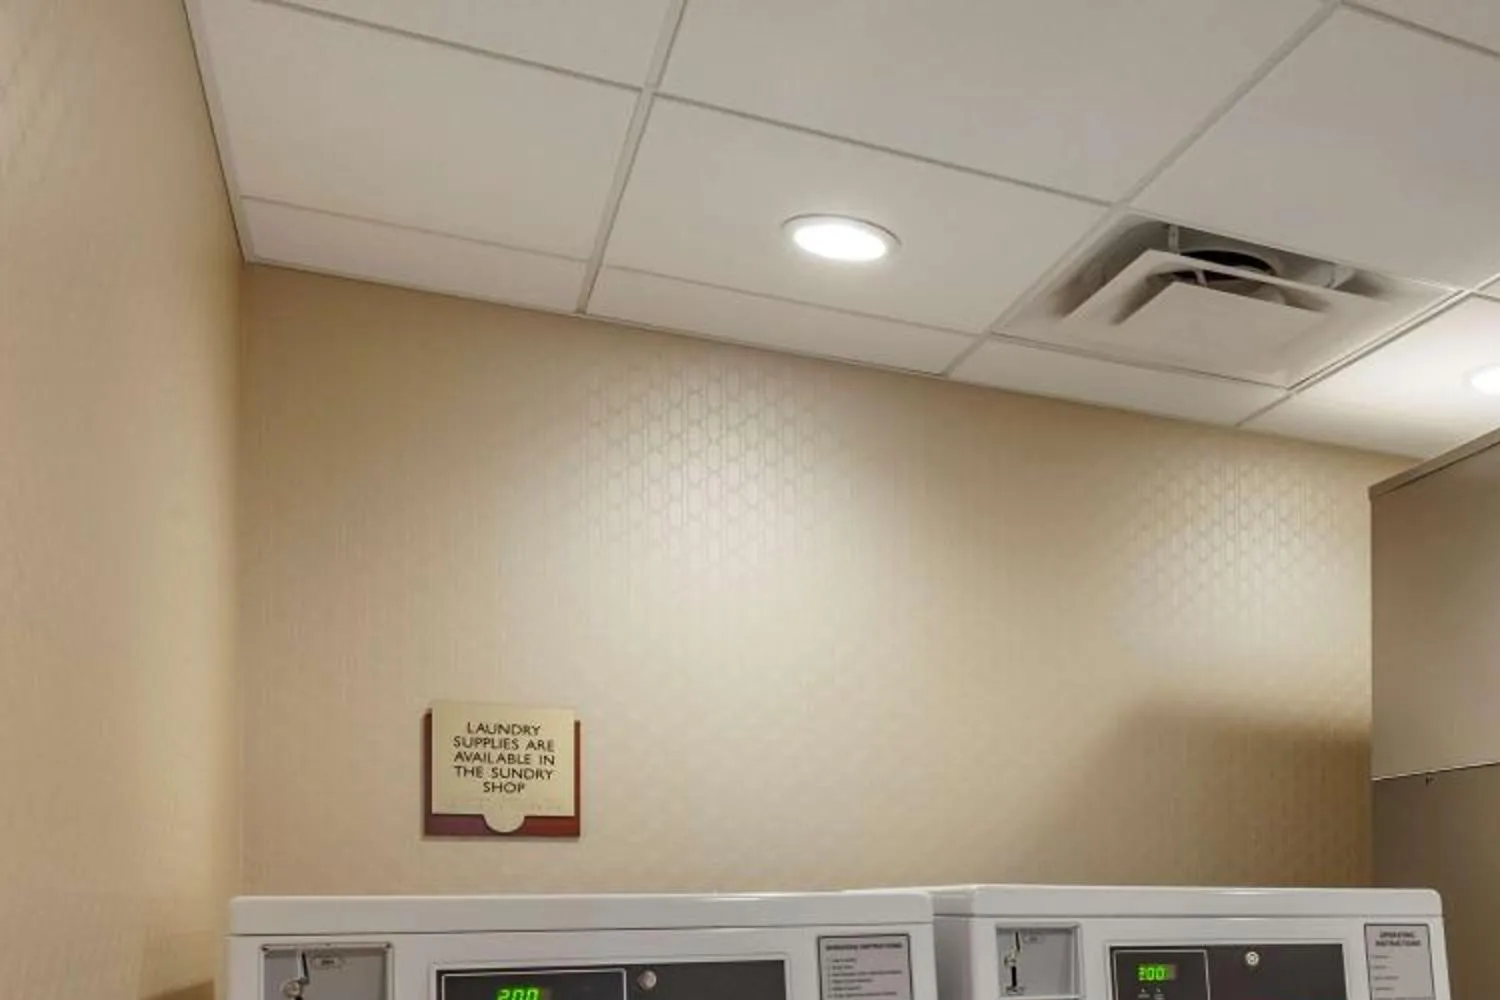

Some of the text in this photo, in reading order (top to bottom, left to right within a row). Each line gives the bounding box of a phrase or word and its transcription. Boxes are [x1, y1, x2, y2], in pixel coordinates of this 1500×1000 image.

[466, 721, 542, 736] LAUNDRY
[453, 735, 555, 752] SUPPLIES ARE
[453, 751, 555, 766] AVAILABLE IN
[454, 765, 554, 781] THE SUNDRY
[483, 781, 526, 793] SHOP
